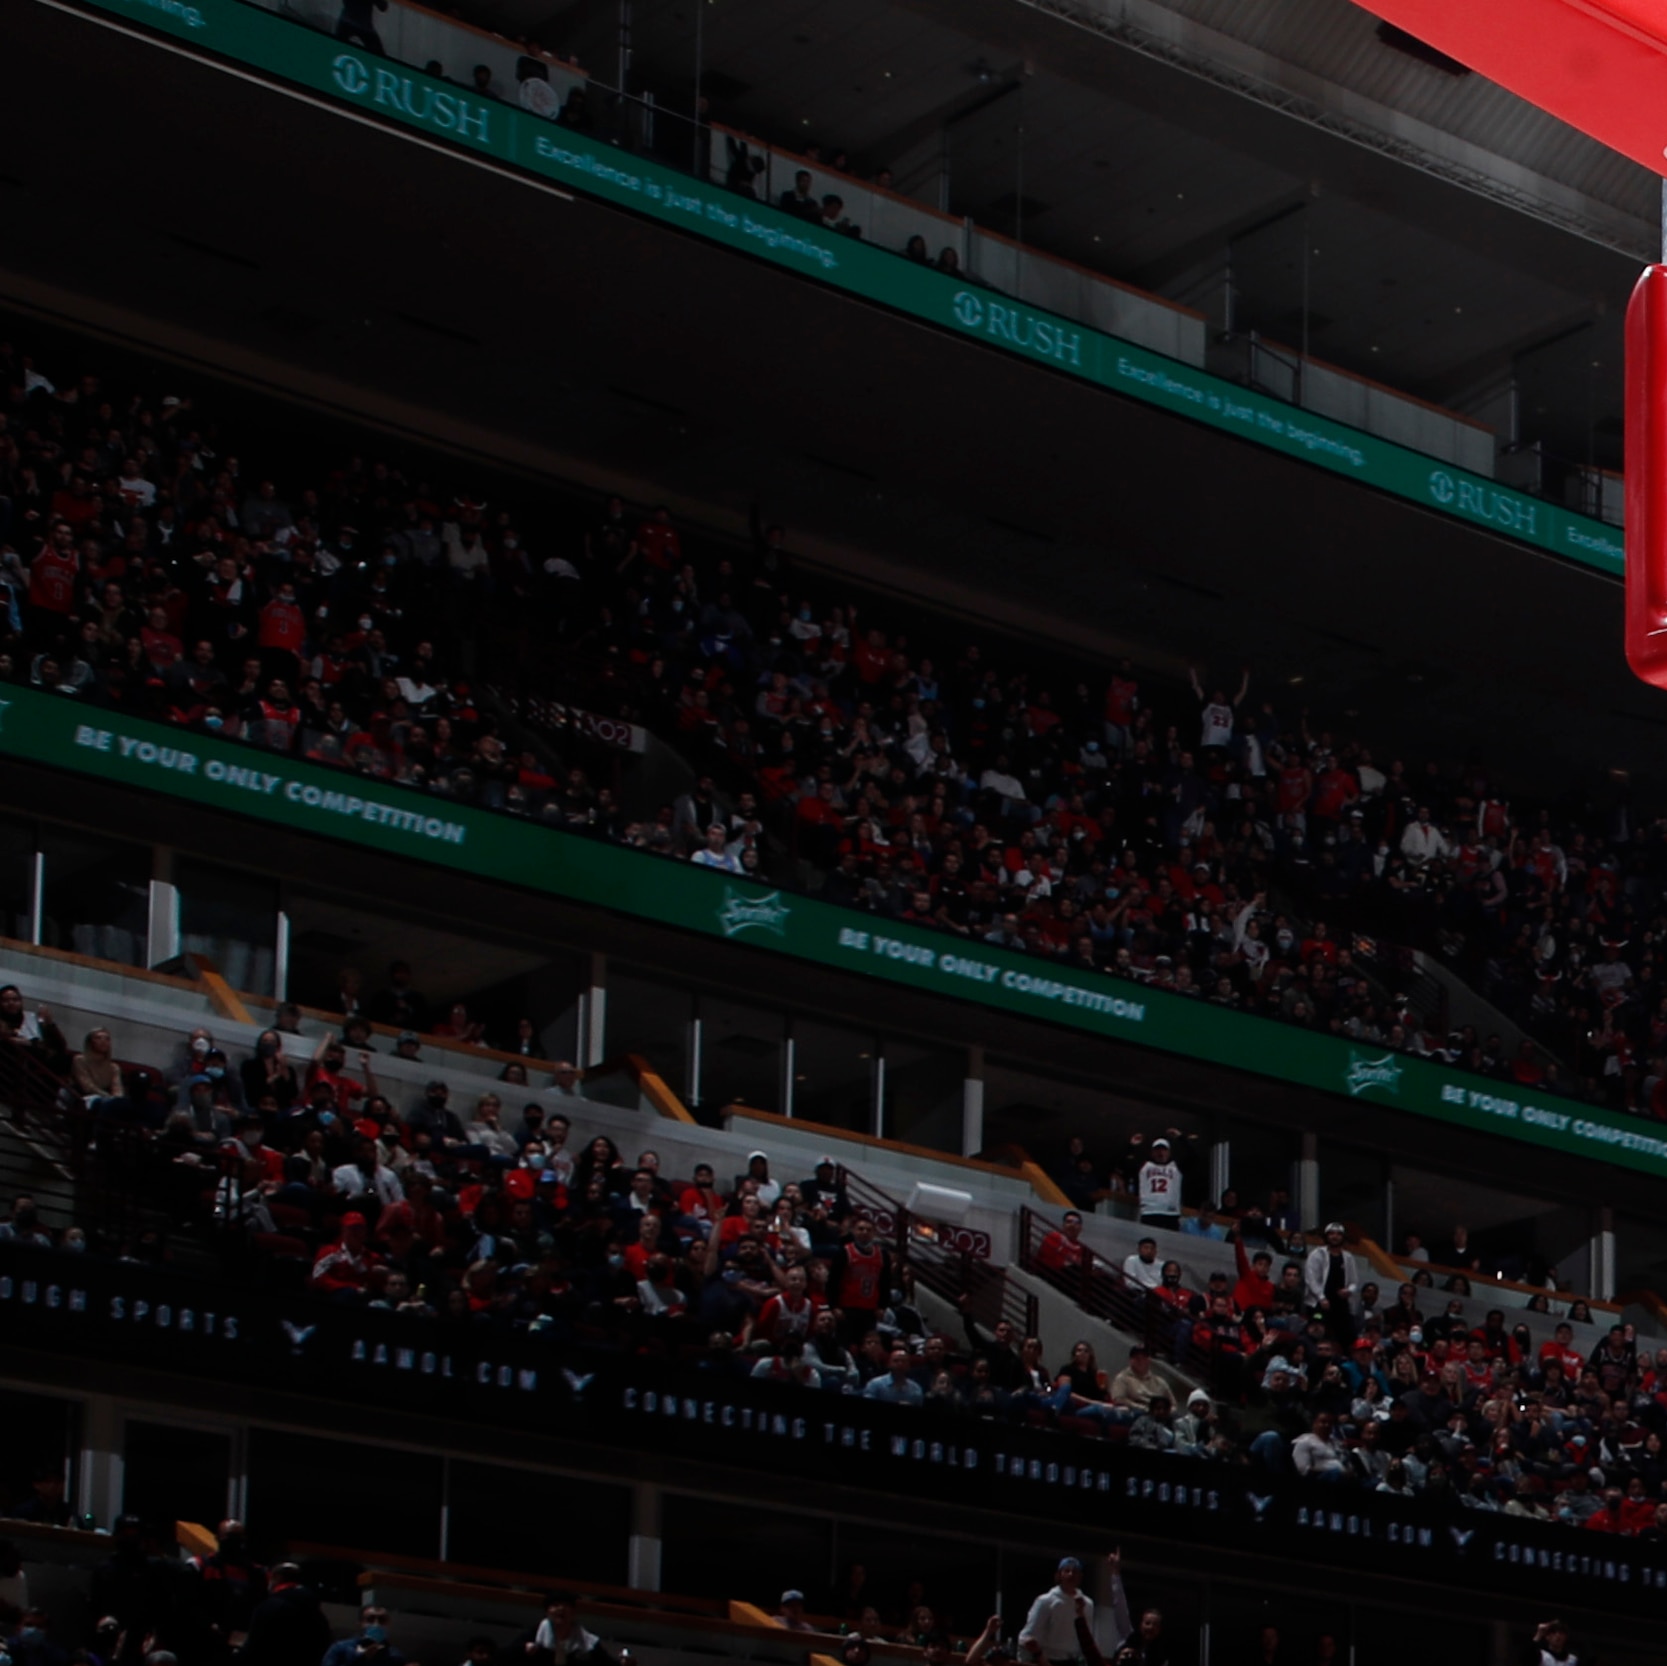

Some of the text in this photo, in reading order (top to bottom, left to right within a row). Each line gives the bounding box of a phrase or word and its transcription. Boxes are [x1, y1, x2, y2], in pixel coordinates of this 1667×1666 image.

[373, 67, 490, 143] RUSH
[535, 136, 838, 269] Excellence is just the beginning.
[987, 304, 1081, 366] RUSH
[1457, 479, 1537, 535] RUSH
[73, 723, 467, 845] BE YOUR ONLY COMPETITION
[837, 926, 1146, 1022] BE YOUR ONLY COMPETITION
[1441, 1083, 1466, 1104] BE
[1468, 1088, 1518, 1119] YOUR
[1520, 1105, 1573, 1132] ONLY
[1150, 1179, 1168, 1193] 12
[109, 1295, 240, 1340] SPORTS
[622, 1386, 1220, 1511] CONNECTING THE WORLD THROUGH SPORTS
[1493, 1541, 1632, 1583] CONNECTING
